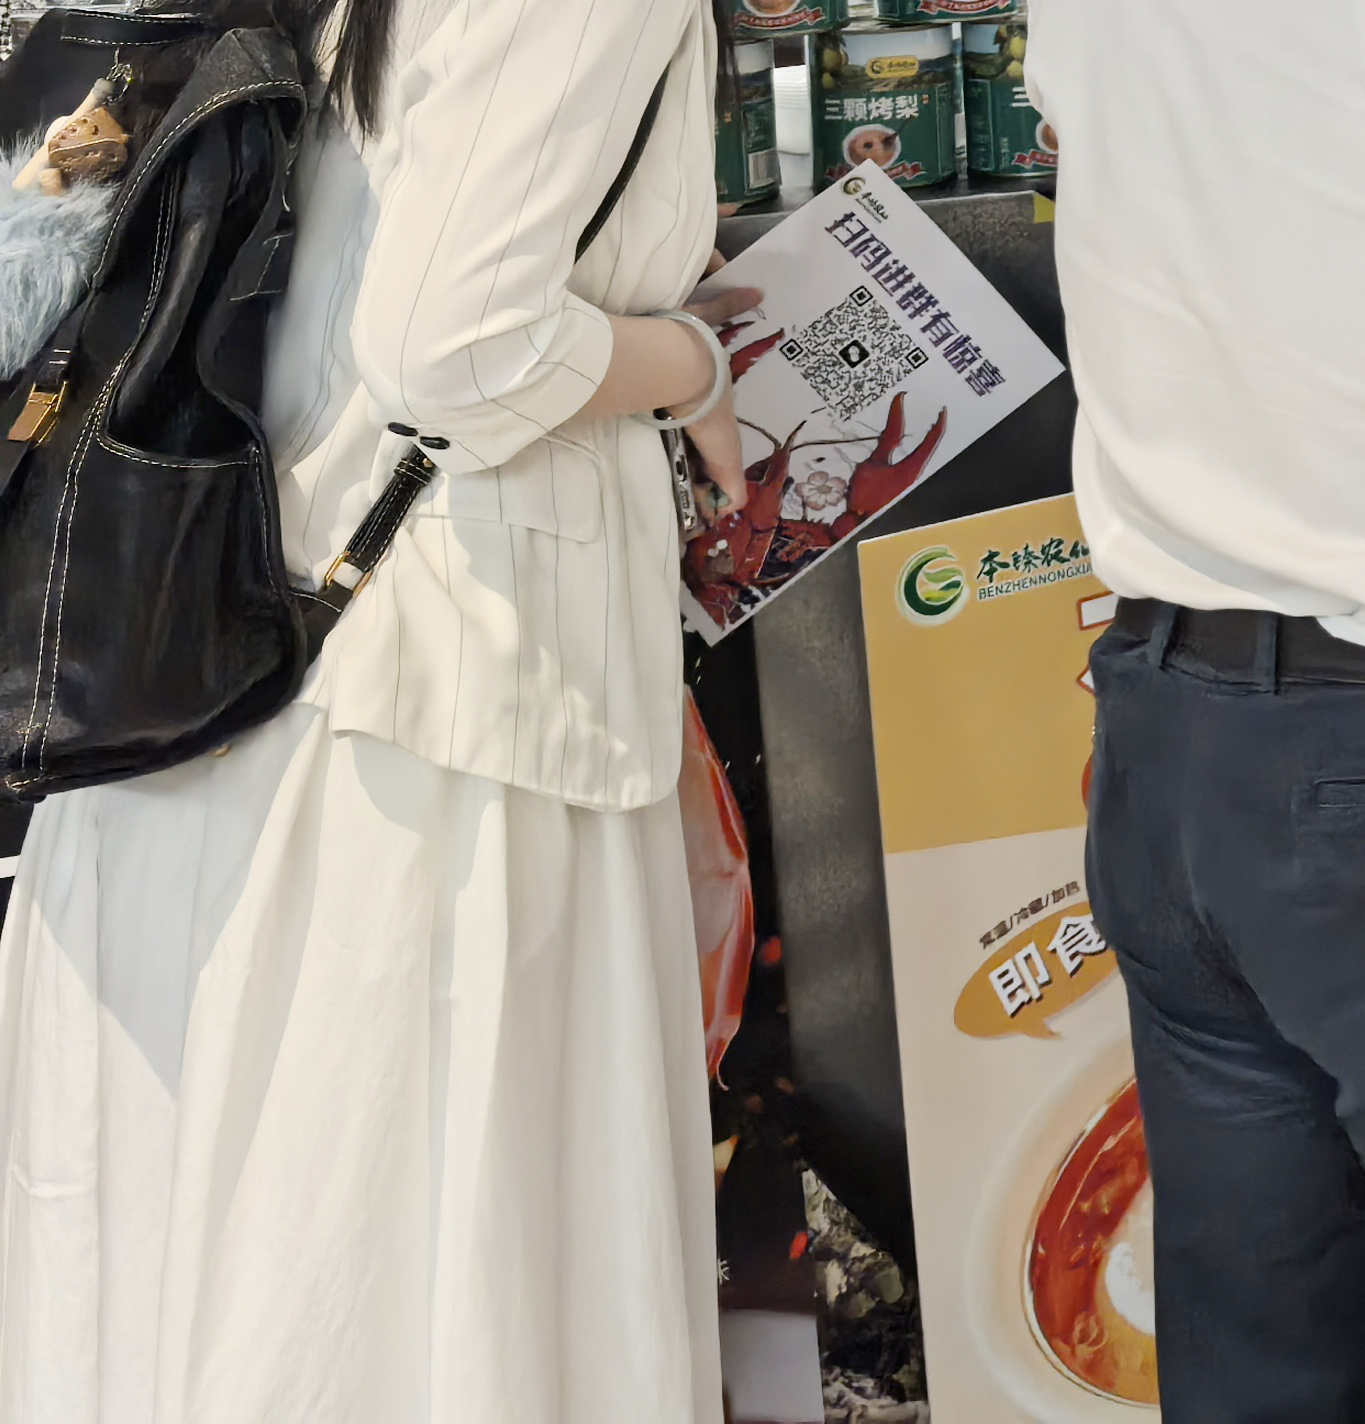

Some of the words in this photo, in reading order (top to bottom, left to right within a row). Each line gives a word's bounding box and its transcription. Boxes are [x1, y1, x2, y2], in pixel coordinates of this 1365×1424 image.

[824, 94, 919, 122] 三颗烤梨
[825, 212, 1006, 397] 扫码进群有惊喜
[988, 914, 1108, 1018] 即食
